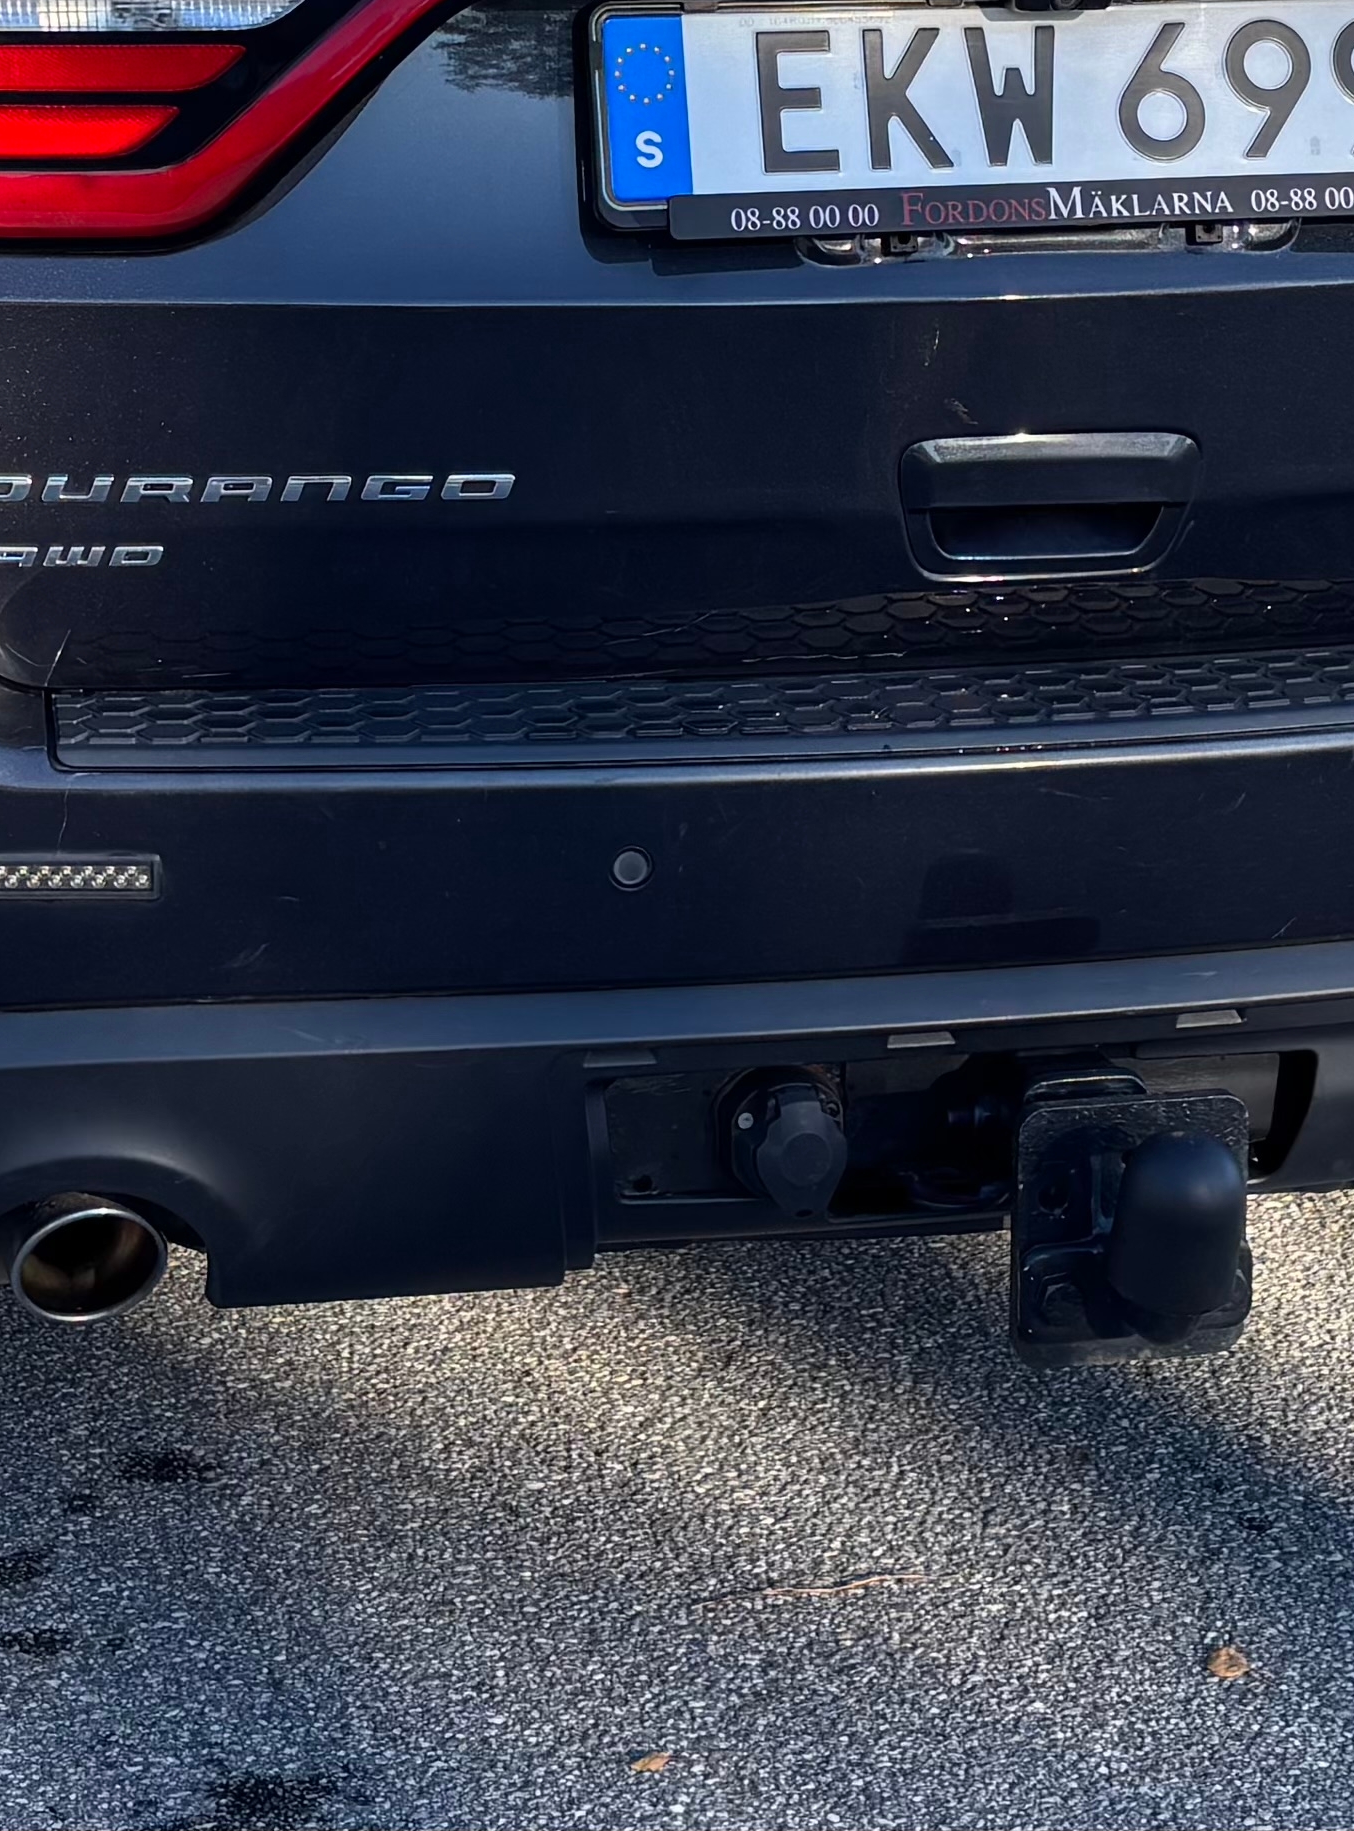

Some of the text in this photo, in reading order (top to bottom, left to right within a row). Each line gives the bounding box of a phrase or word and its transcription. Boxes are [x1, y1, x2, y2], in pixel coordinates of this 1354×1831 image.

[756, 26, 1055, 174] EKW
[635, 130, 663, 168] S
[731, 206, 801, 232] 08-88
[809, 204, 841, 229] 00
[848, 203, 880, 228] 00
[1250, 187, 1318, 213] 08-88
[1325, 186, 1354, 210] 00
